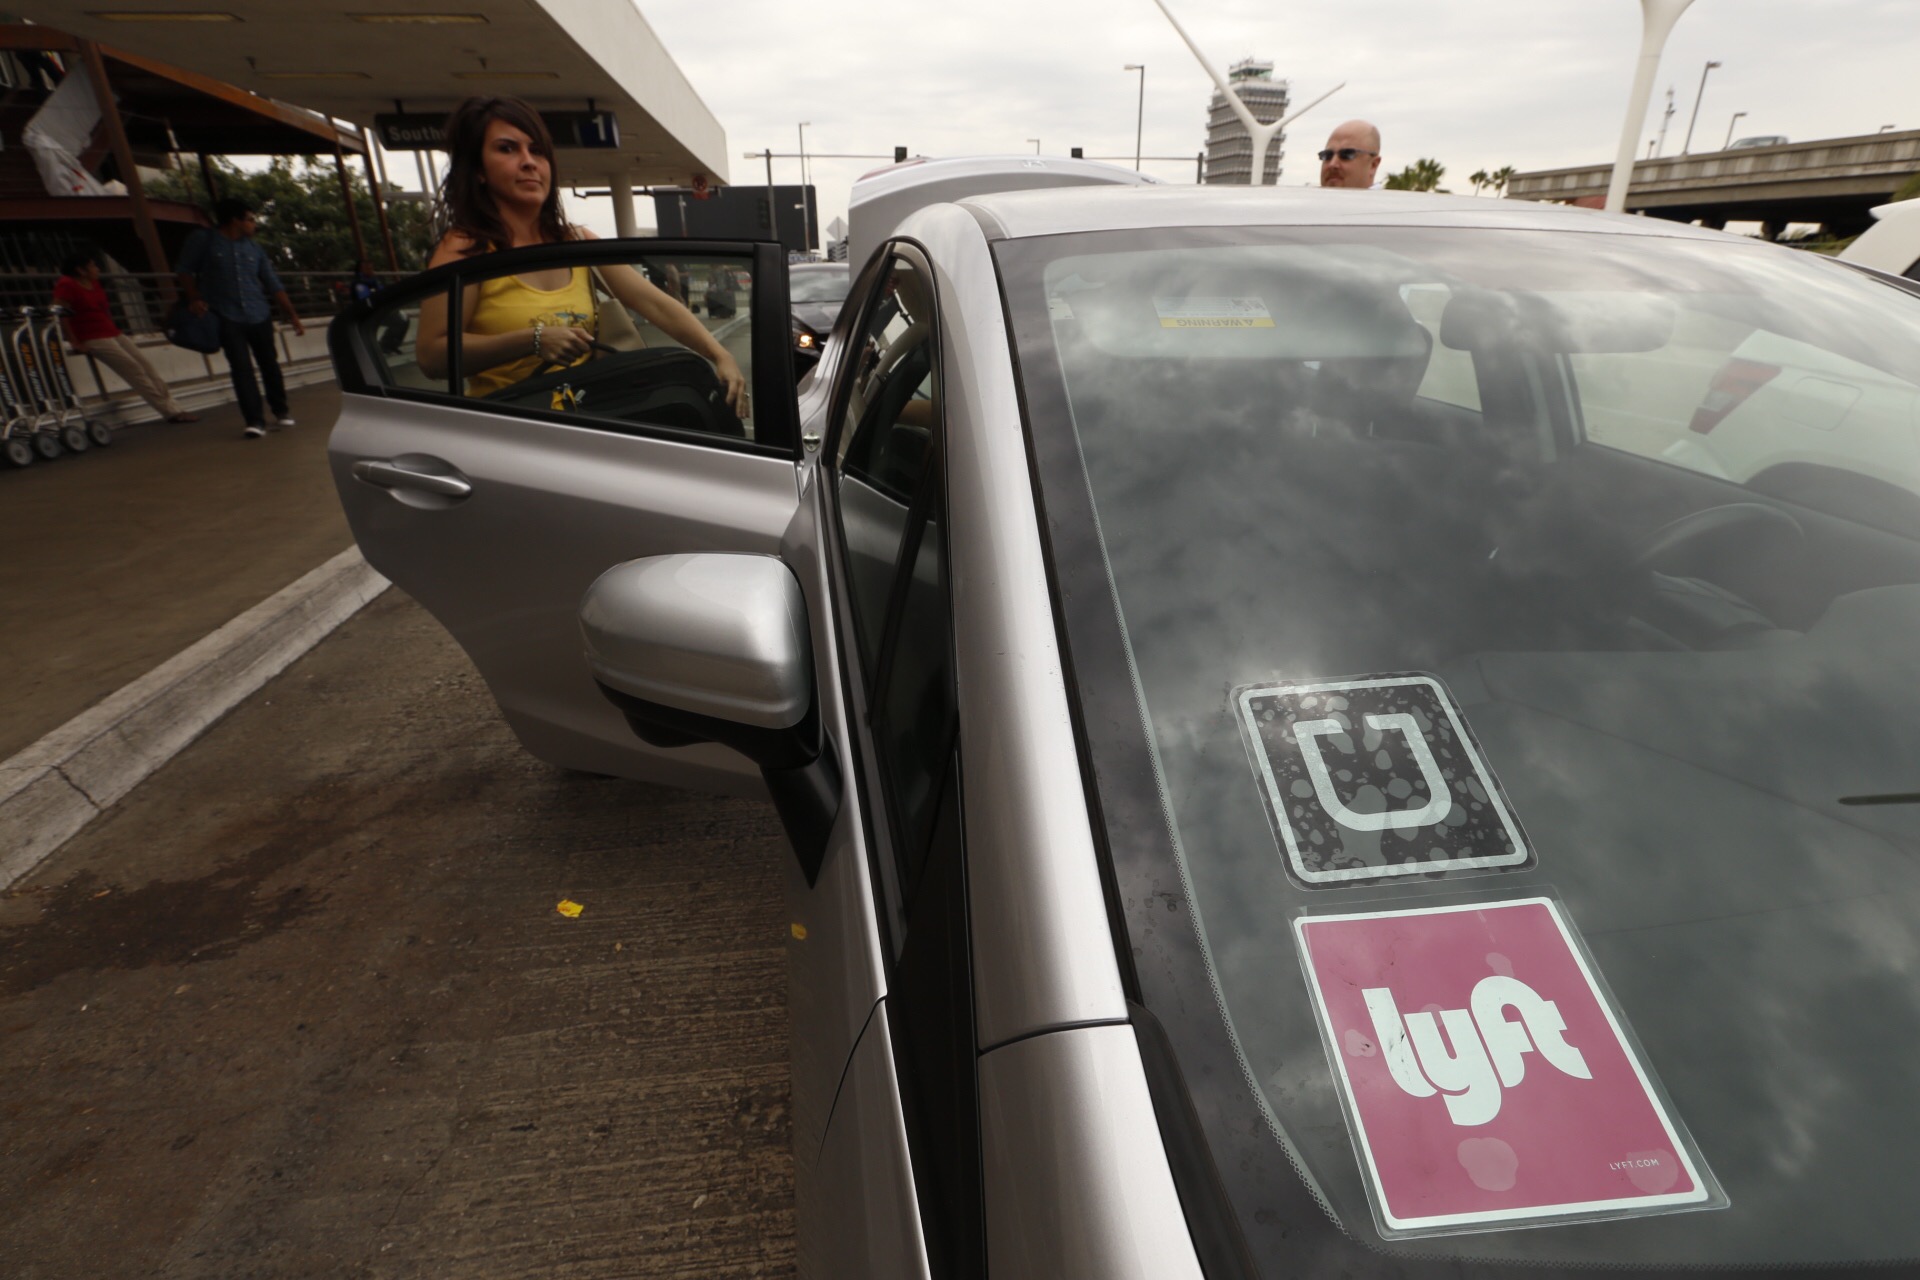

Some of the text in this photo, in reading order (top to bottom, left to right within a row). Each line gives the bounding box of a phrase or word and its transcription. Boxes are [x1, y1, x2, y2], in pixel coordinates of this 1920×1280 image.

[592, 114, 606, 141] 1
[1176, 318, 1243, 327] WARNING
[1361, 975, 1593, 1126] lyft
[1609, 1158, 1660, 1171] LYFT.COM
